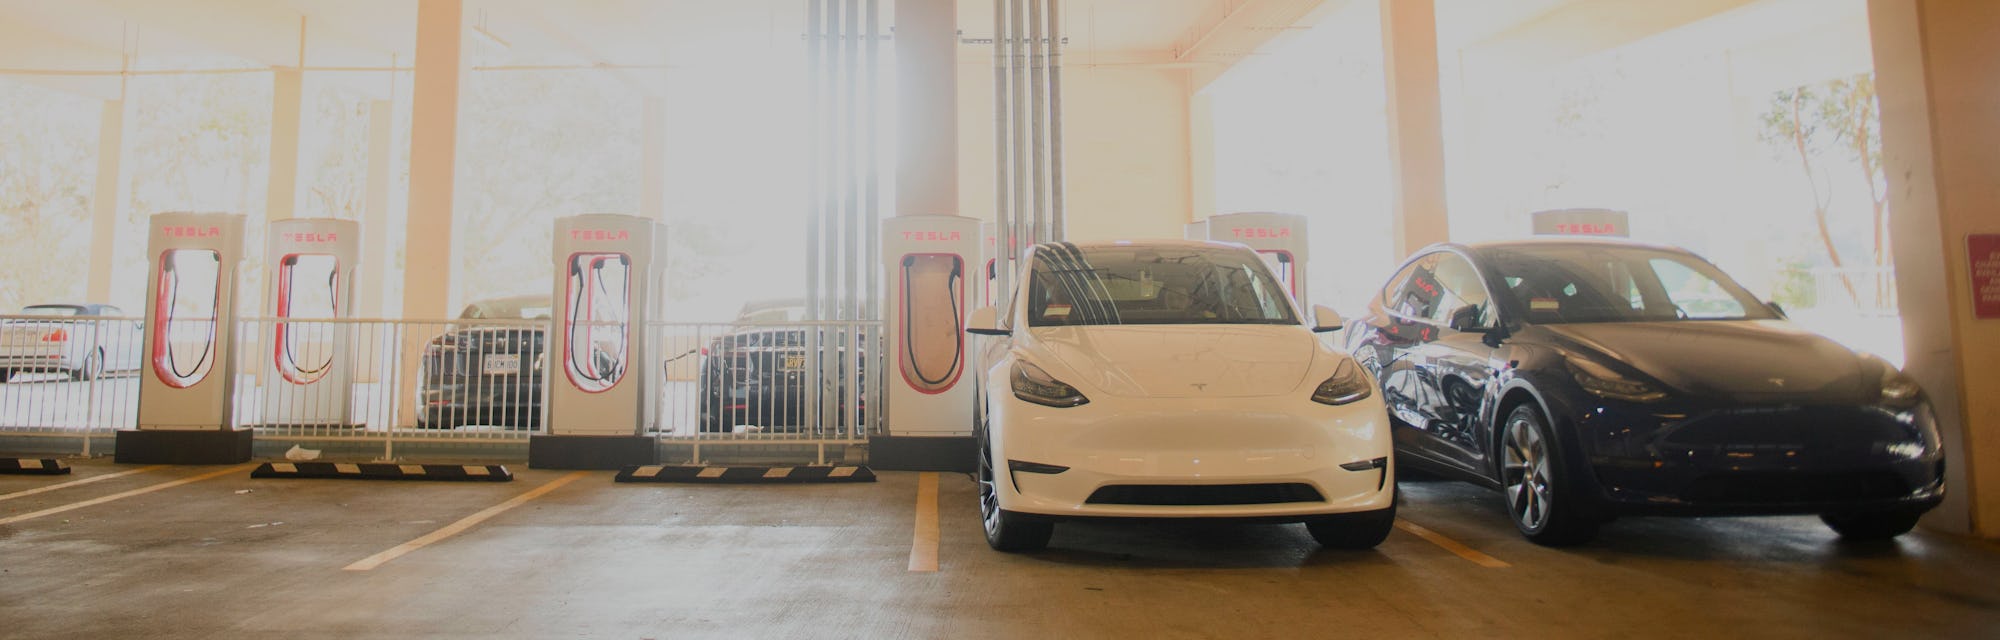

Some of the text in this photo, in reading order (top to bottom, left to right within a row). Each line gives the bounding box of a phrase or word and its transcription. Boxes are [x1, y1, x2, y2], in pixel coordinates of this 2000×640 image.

[163, 226, 219, 237] TESLA
[1231, 228, 1291, 238] TESLA
[1556, 224, 1614, 233] TESLA
[284, 233, 337, 242] TESLA
[570, 230, 629, 240] TESLA
[903, 231, 961, 240] TESLA
